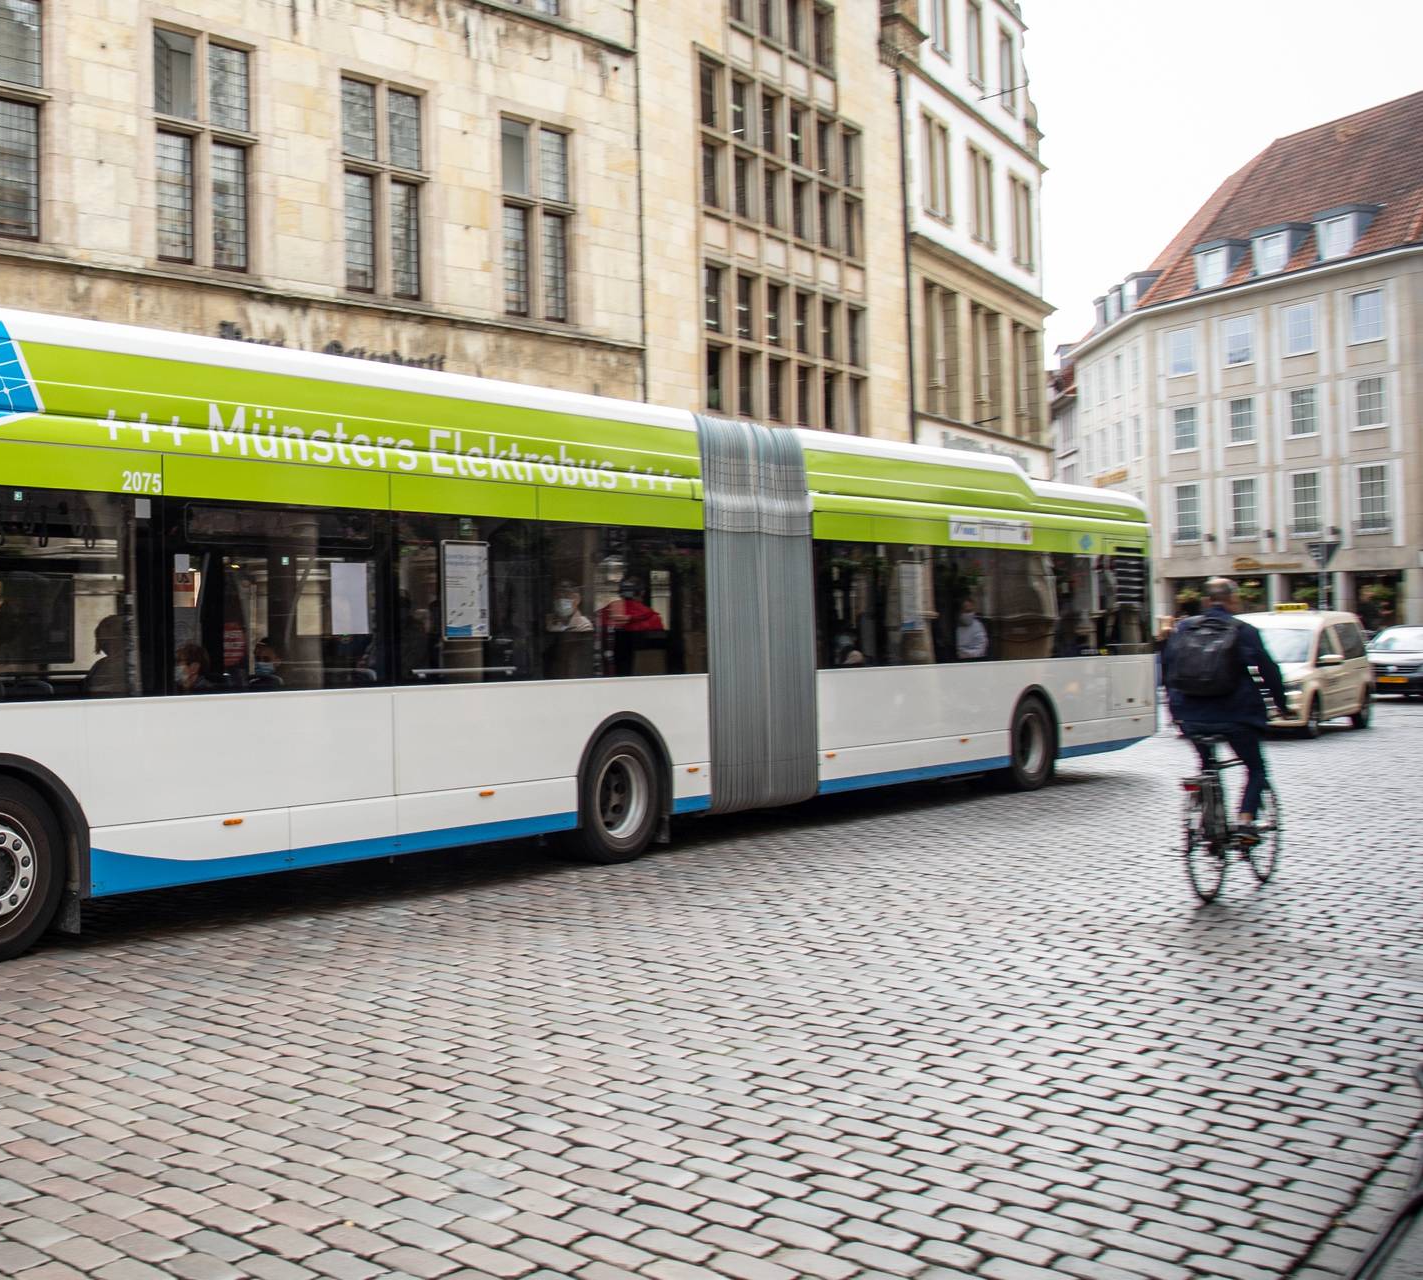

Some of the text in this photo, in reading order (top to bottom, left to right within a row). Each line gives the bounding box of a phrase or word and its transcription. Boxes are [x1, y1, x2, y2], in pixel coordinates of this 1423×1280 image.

[208, 403, 418, 471] Münsters
[430, 429, 617, 491] Elektrobus
[122, 471, 162, 493] 2075
